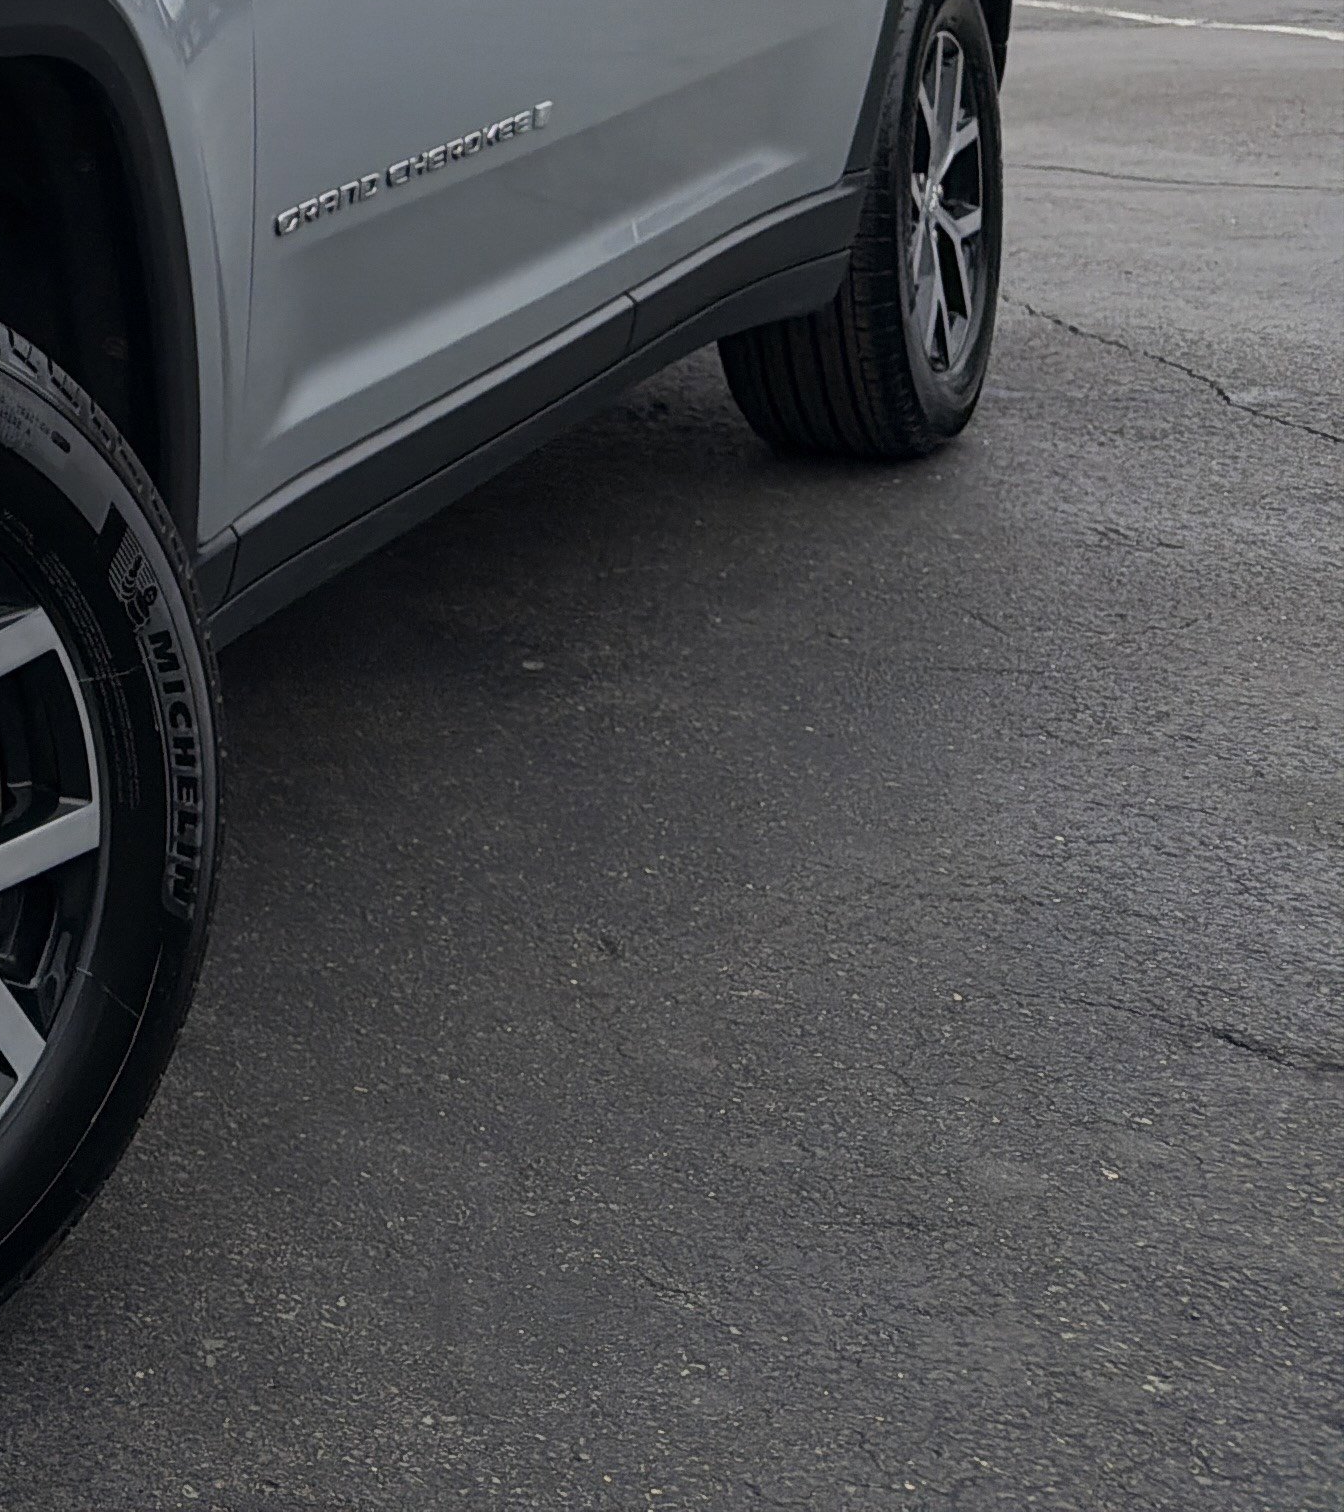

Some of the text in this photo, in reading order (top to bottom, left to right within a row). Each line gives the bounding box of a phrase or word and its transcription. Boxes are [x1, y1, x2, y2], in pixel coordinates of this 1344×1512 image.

[273, 172, 381, 236] GRAND
[385, 110, 532, 188] CHEROKEE
[148, 629, 201, 908] MICHELIN
